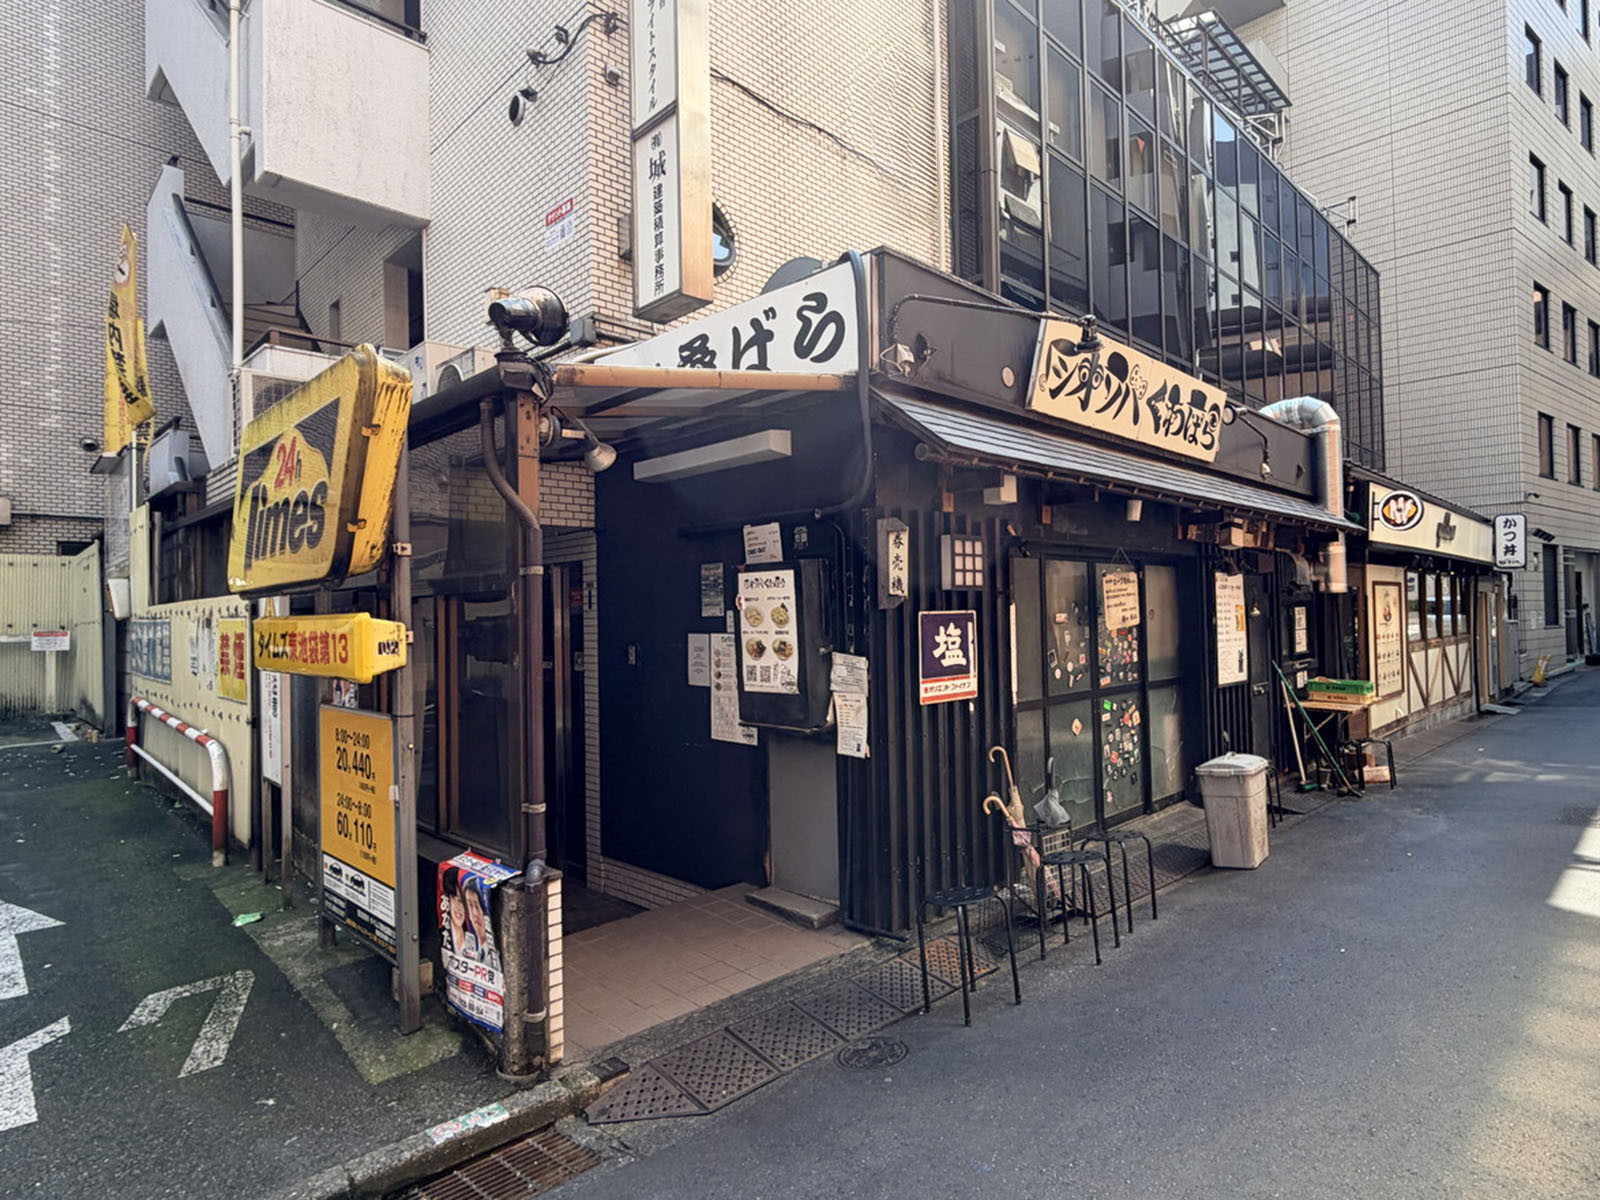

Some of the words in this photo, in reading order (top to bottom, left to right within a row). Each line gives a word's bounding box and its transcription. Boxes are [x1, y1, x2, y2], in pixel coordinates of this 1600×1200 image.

[1502, 517, 1518, 557] かつ丼
[932, 621, 968, 668] 塩
